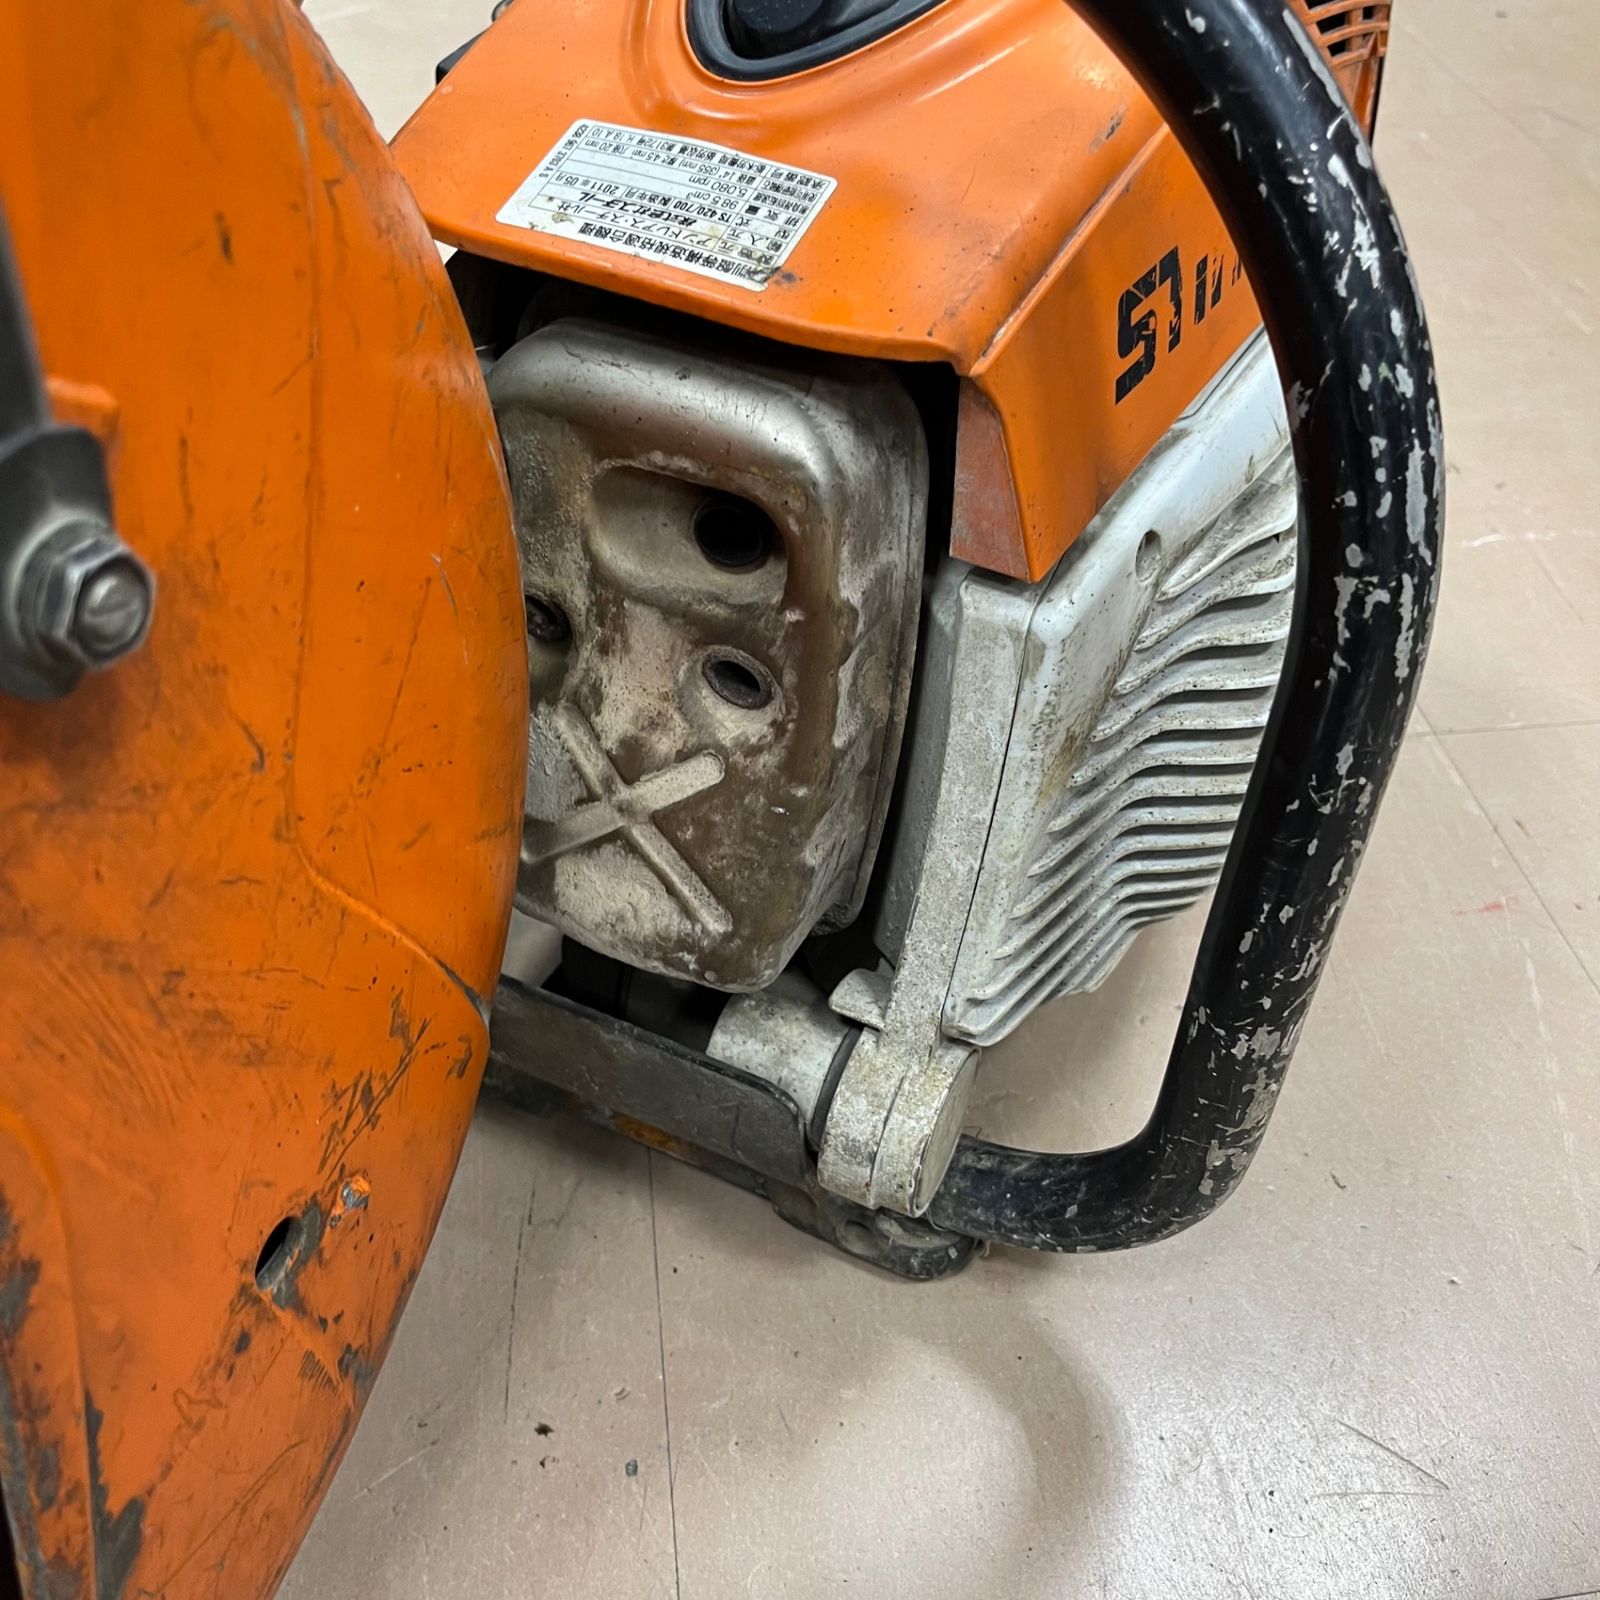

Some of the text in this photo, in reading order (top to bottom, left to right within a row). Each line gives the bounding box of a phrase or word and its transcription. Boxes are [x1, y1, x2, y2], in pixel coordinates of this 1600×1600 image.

[597, 141, 613, 151] 20
[687, 173, 712, 186] rpm
[575, 190, 698, 228] 株式会社スチール
[671, 199, 719, 218] 420/700
[717, 212, 733, 222] TS
[576, 221, 769, 280] 削盤等構造規格適合機種
